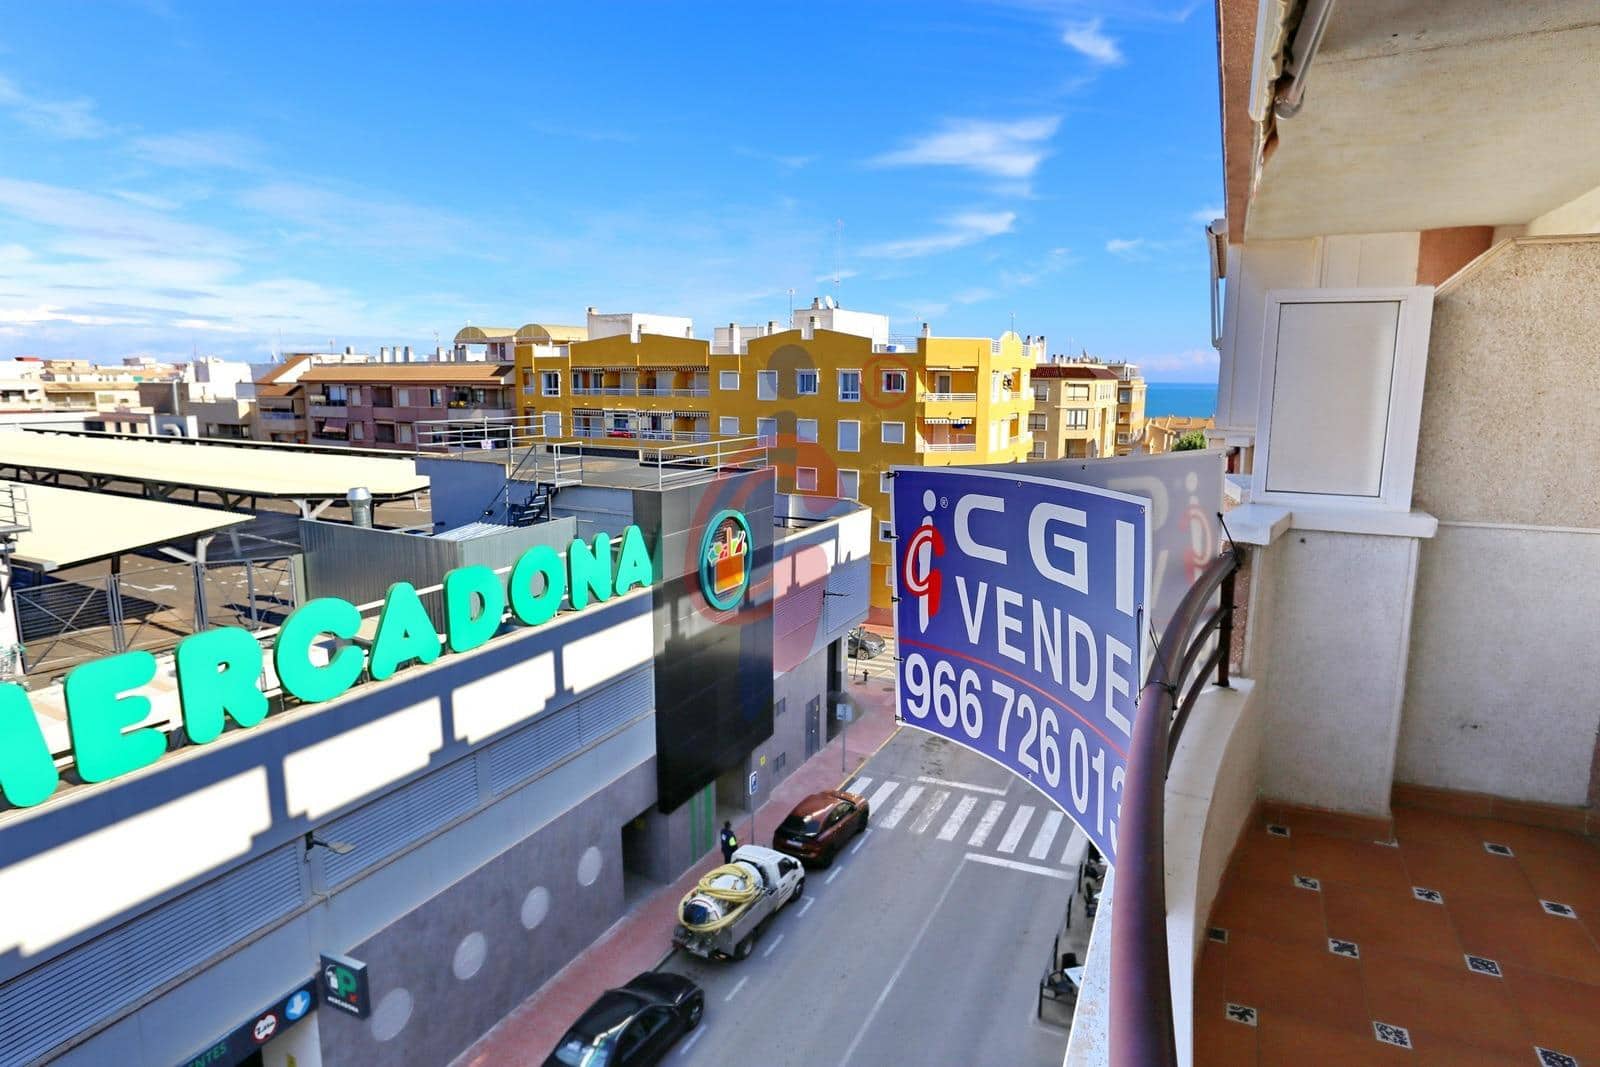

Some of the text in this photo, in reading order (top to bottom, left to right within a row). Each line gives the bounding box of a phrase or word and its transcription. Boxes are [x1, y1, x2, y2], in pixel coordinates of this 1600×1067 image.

[954, 494, 1135, 618] CGI
[905, 653, 983, 739] 966
[992, 680, 1060, 788] 726
[955, 576, 1132, 738] VENDE
